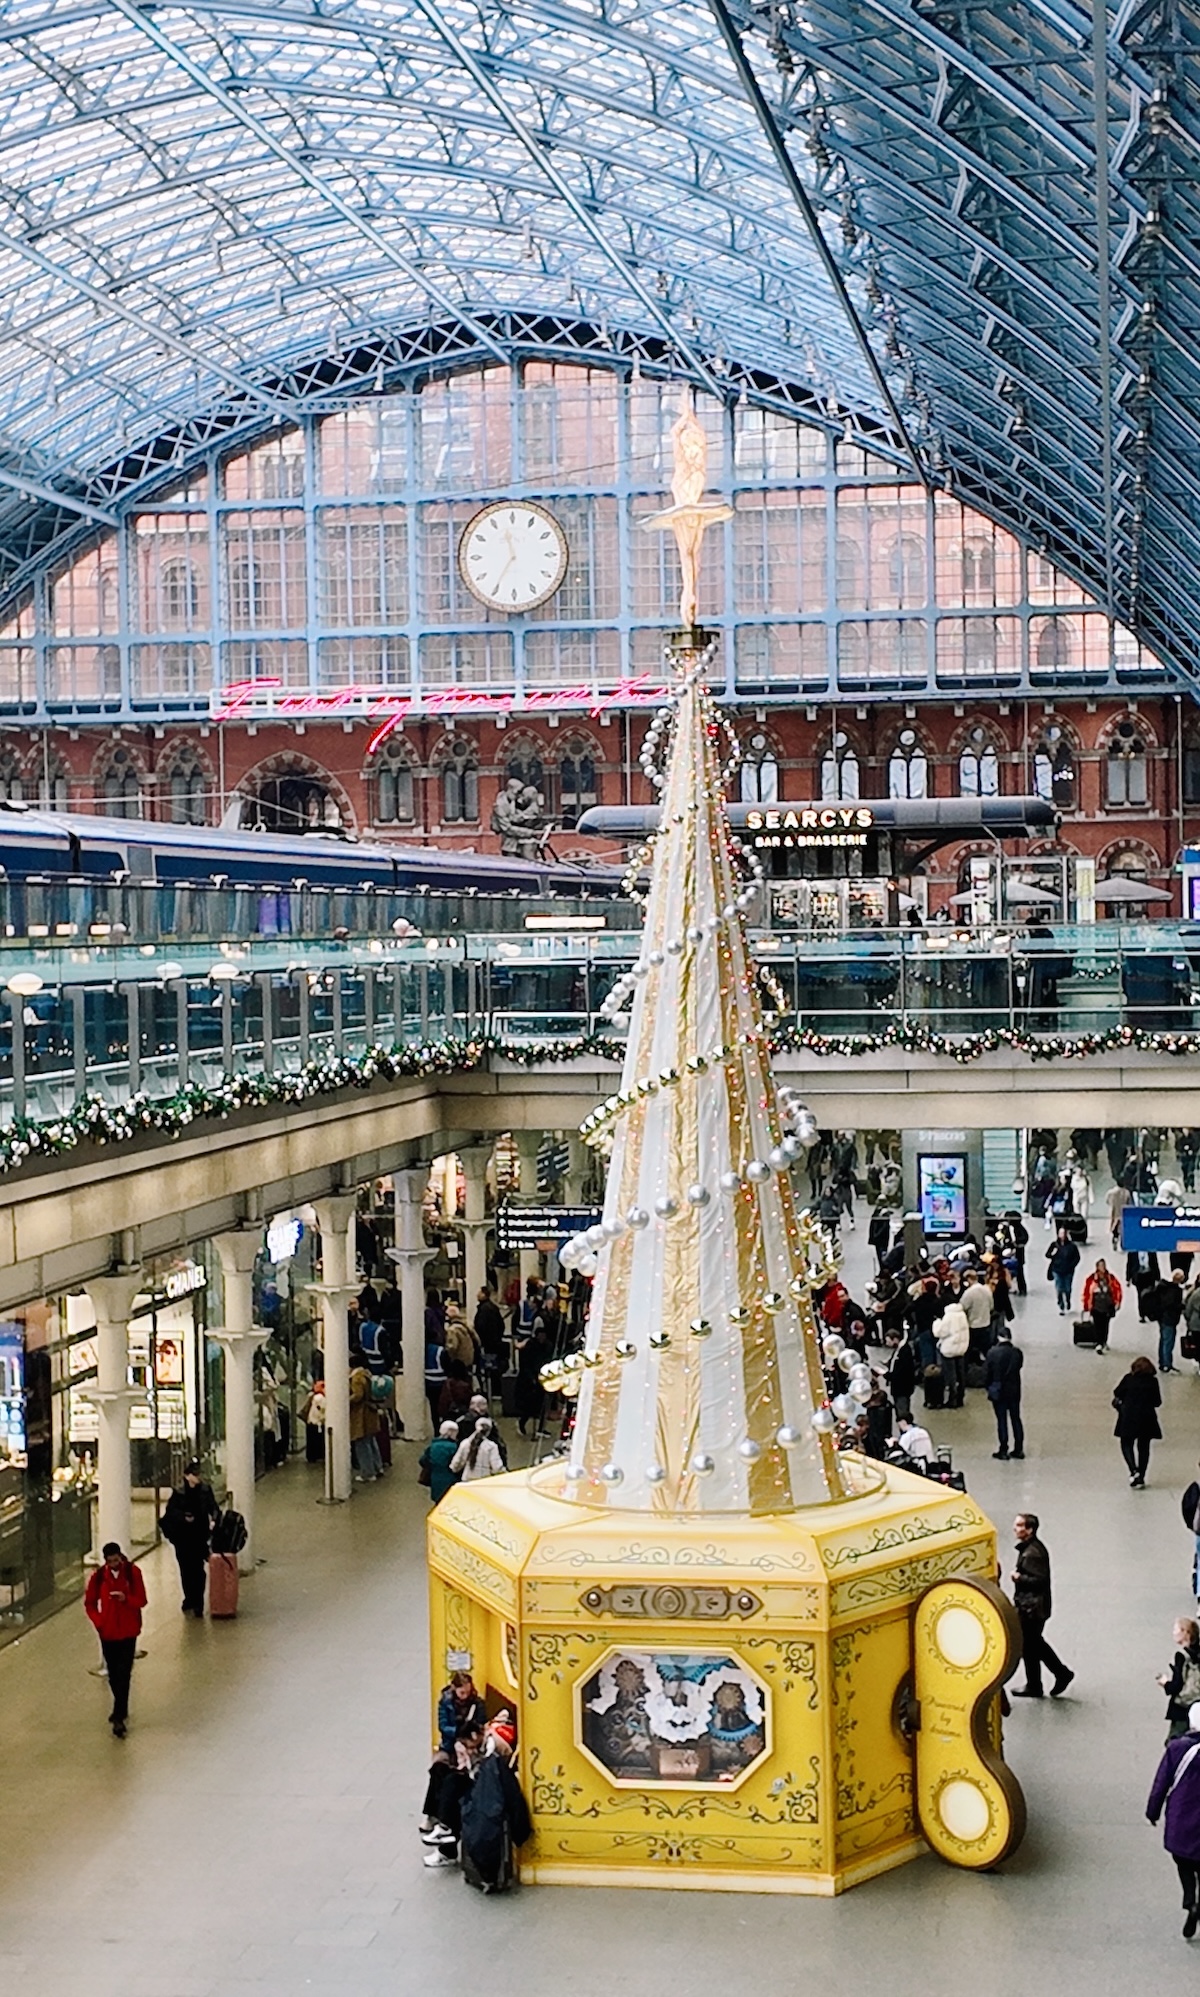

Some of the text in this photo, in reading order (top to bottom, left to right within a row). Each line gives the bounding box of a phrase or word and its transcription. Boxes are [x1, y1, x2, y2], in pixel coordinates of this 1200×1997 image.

[211, 677, 281, 721] I
[747, 809, 872, 829] SEARCYS
[755, 834, 868, 848] BAR & BRASSERIE
[166, 1265, 207, 1299] CHANEL
